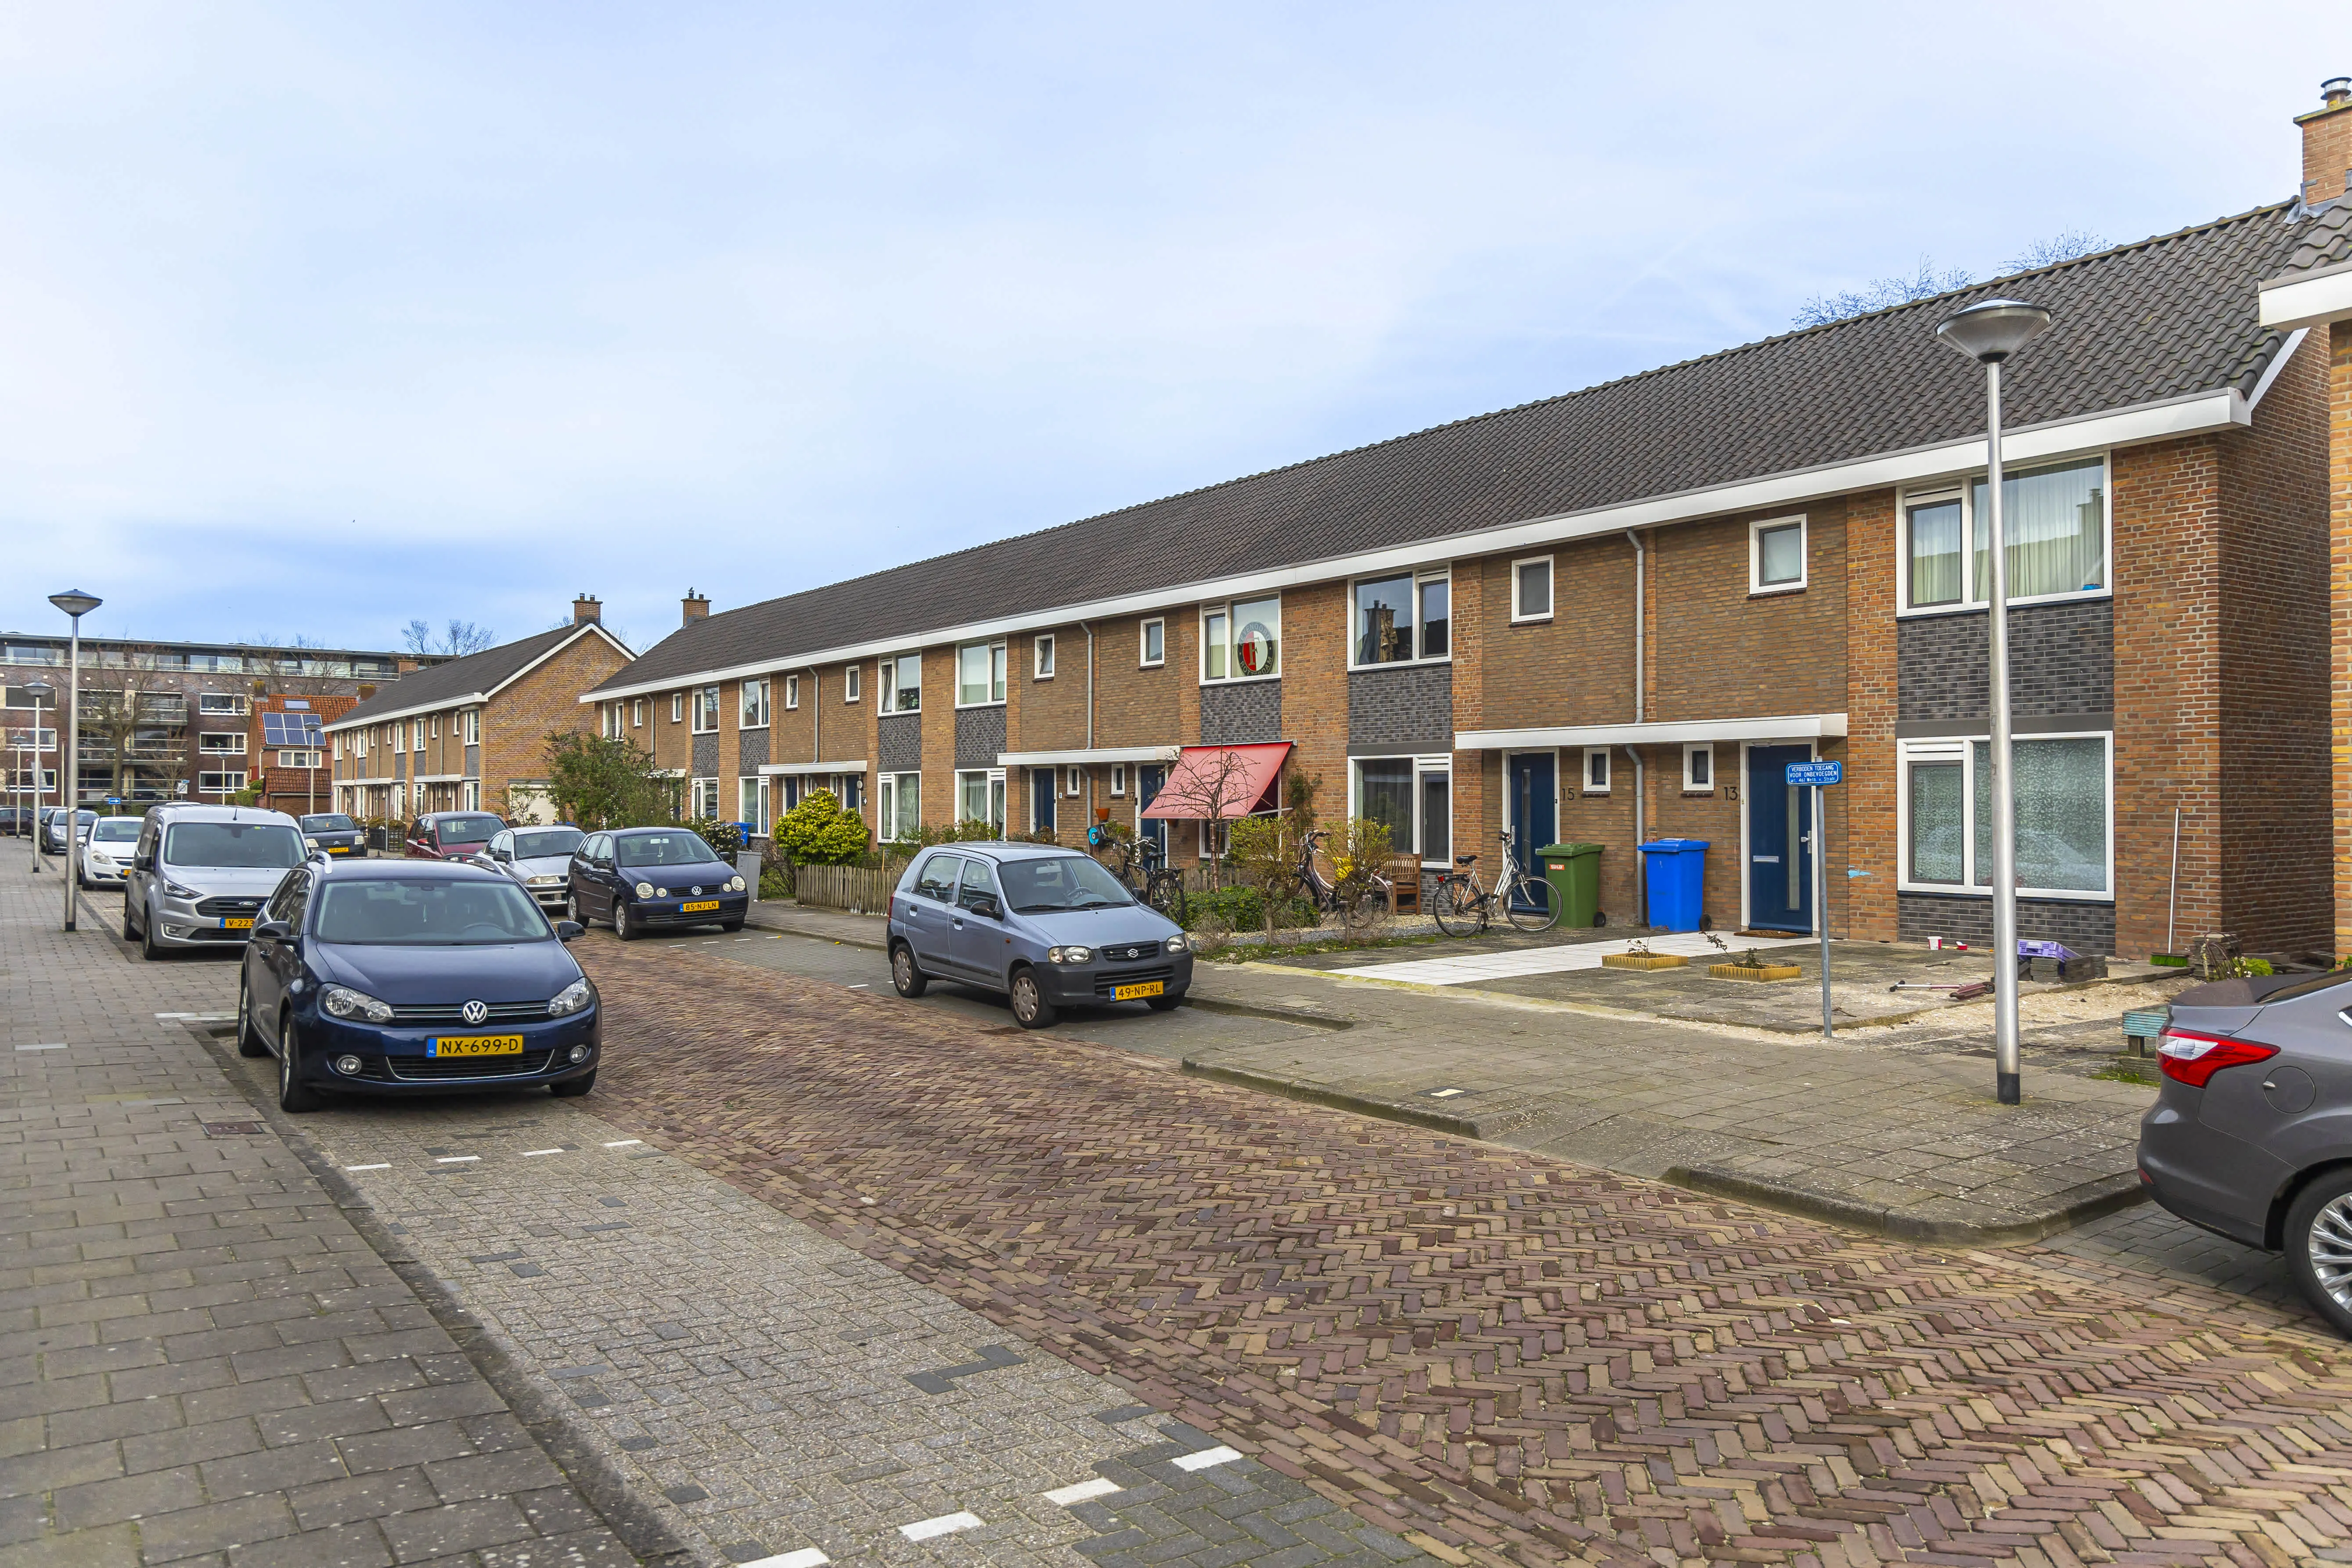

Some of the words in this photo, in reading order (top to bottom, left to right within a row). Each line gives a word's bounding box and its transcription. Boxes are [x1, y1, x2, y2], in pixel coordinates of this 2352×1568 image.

[1128, 792, 1135, 801] 17
[1562, 788, 1574, 801] 15
[1724, 786, 1738, 800] 13
[1118, 984, 1161, 998] 49-NP-RL
[441, 1038, 519, 1054] NX-699-D
